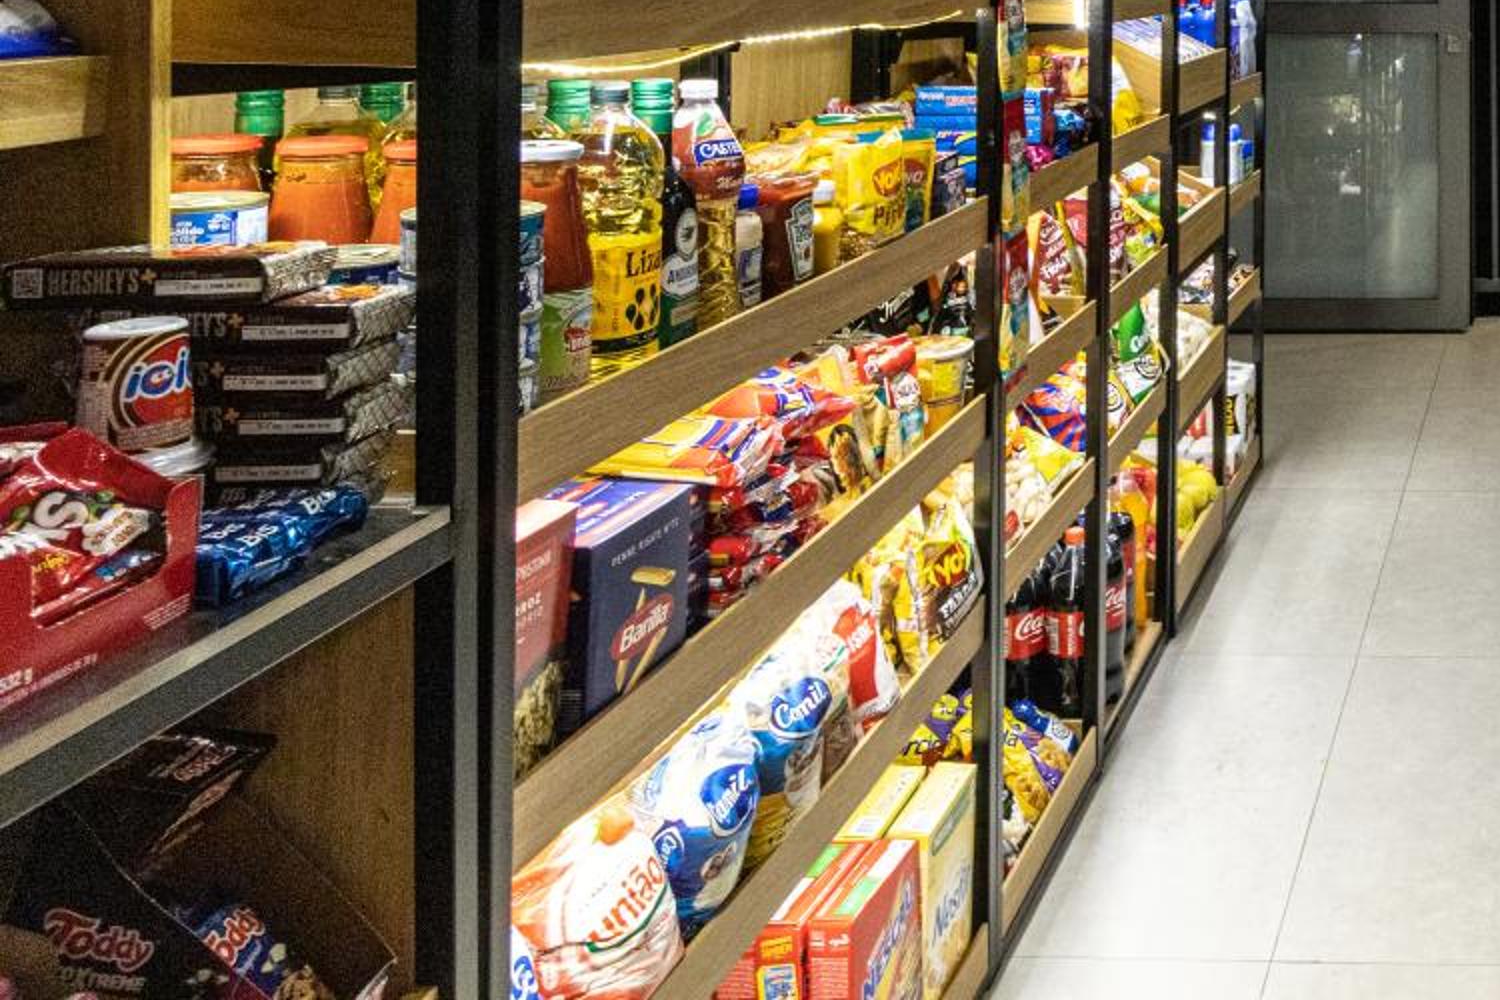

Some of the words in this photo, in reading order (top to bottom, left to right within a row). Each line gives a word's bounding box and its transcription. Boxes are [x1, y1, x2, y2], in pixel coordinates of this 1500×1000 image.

[47, 267, 140, 297] HERSHEY'S
[619, 601, 670, 654] Barilla
[773, 679, 829, 729] Camil
[44, 906, 155, 973] Toddy
